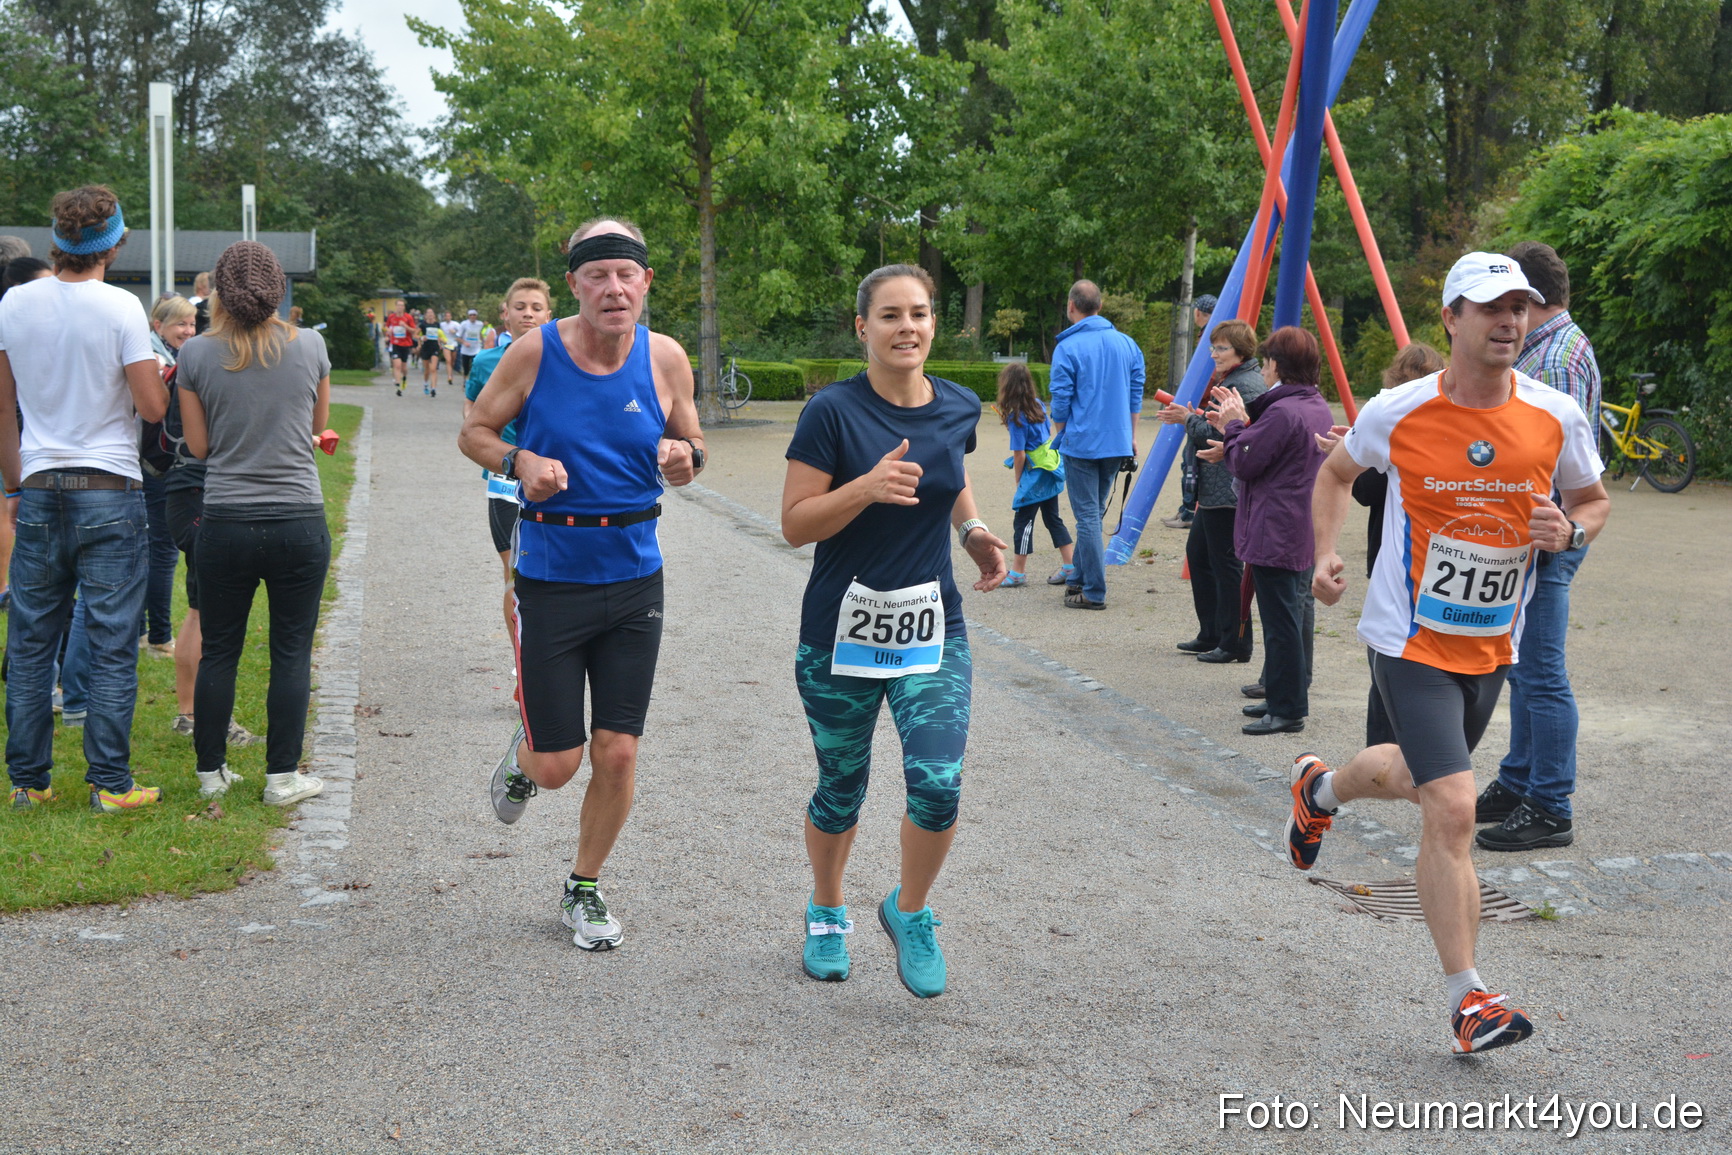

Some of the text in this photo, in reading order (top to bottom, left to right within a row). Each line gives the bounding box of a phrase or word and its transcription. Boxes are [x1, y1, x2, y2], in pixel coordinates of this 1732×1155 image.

[1423, 476, 1535, 493] SportScheck
[1431, 542, 1518, 566] PARTL Neumarkt
[1431, 560, 1519, 603] 2150
[846, 591, 928, 609] PARTL Neumarkt
[1442, 607, 1497, 625] Günther
[847, 608, 935, 645] 2580
[874, 650, 903, 666] Ulla
